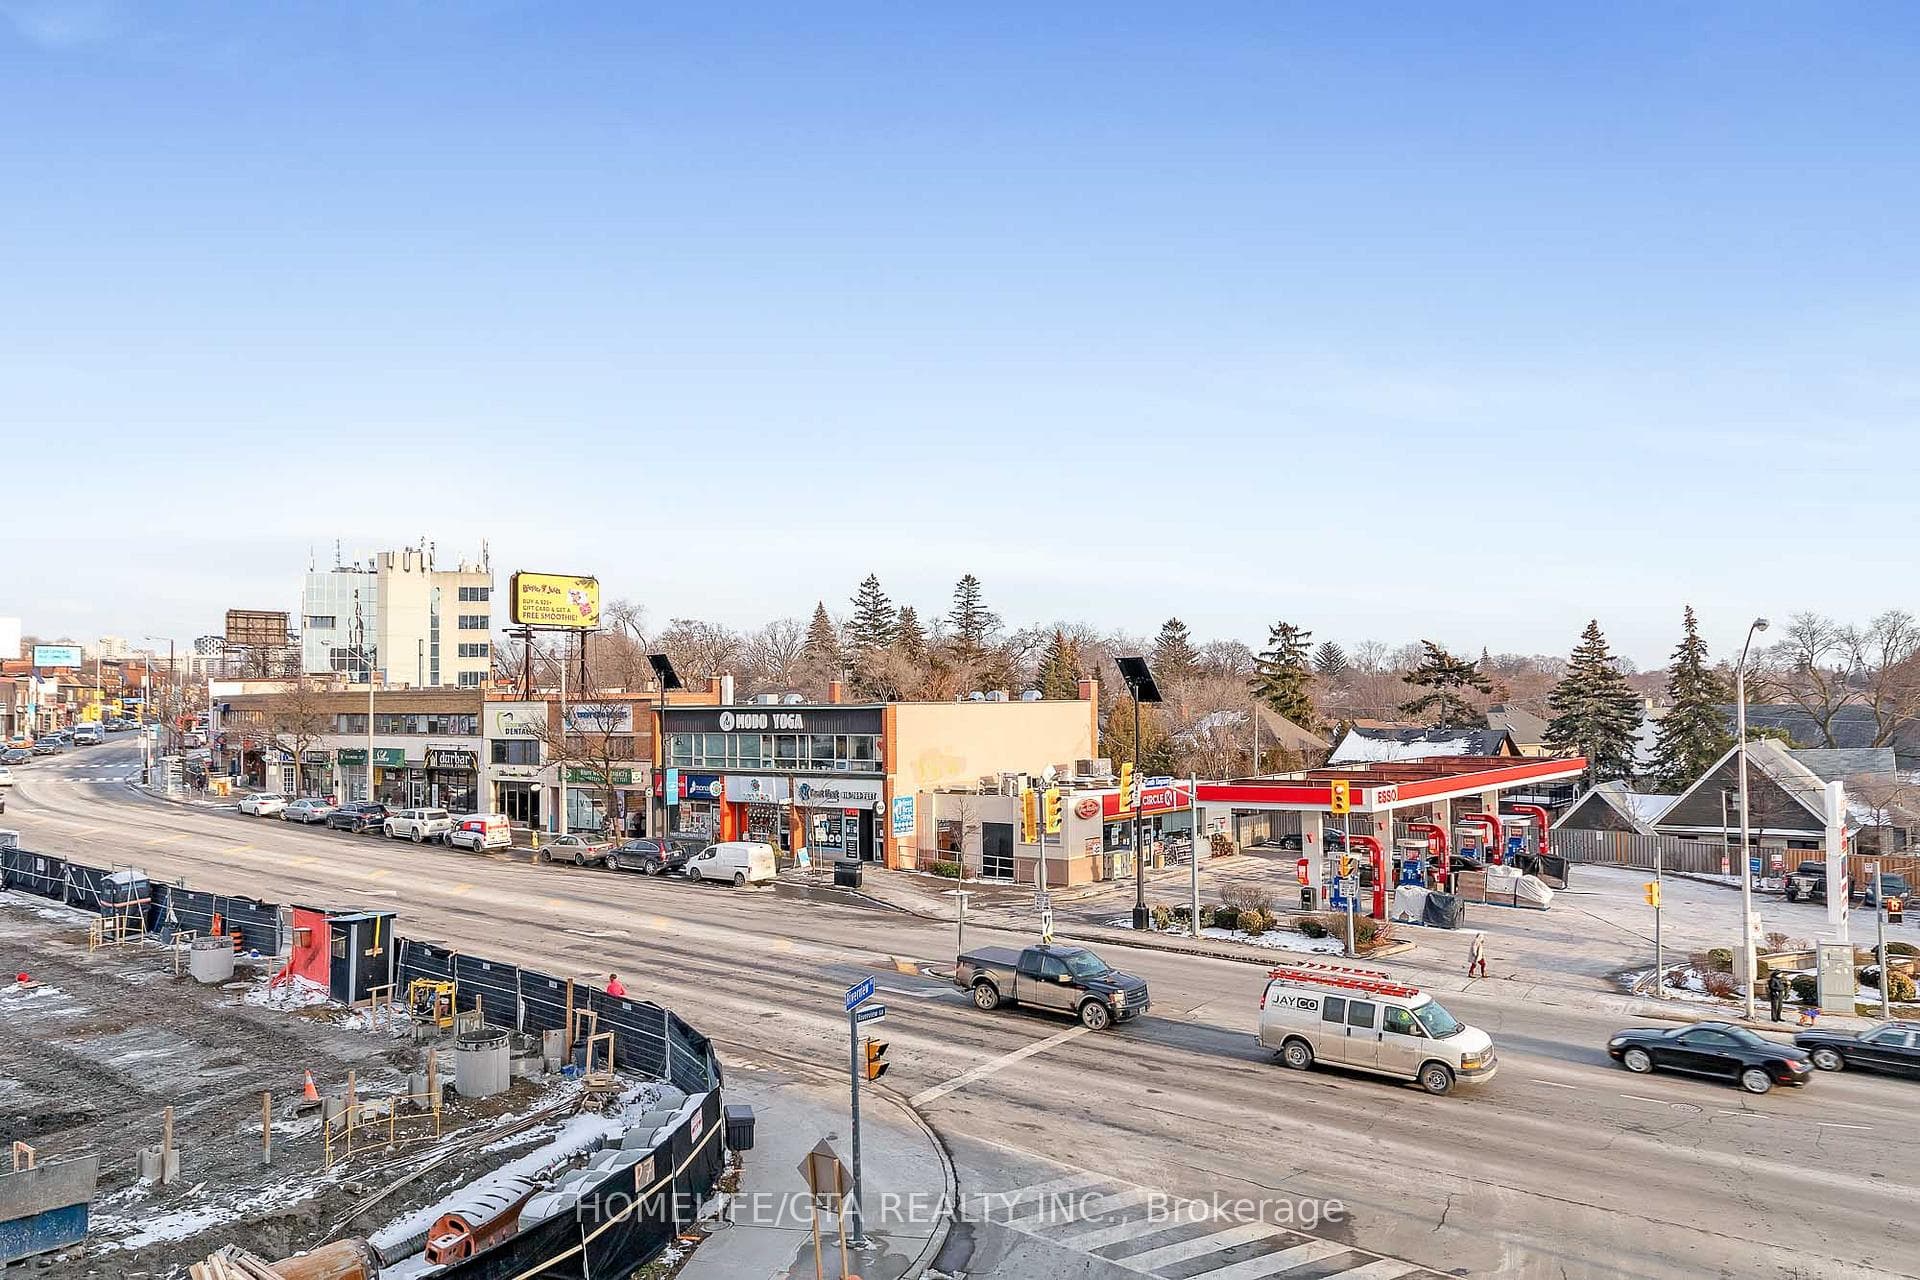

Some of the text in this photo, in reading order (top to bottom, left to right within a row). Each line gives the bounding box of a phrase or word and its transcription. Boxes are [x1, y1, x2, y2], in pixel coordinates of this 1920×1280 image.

[541, 613, 578, 621] SMOOTHIE!
[772, 713, 804, 730] YOGA
[439, 751, 470, 765] durbar
[1142, 795, 1164, 806] CIRCLE
[1377, 790, 1397, 803] ESSO
